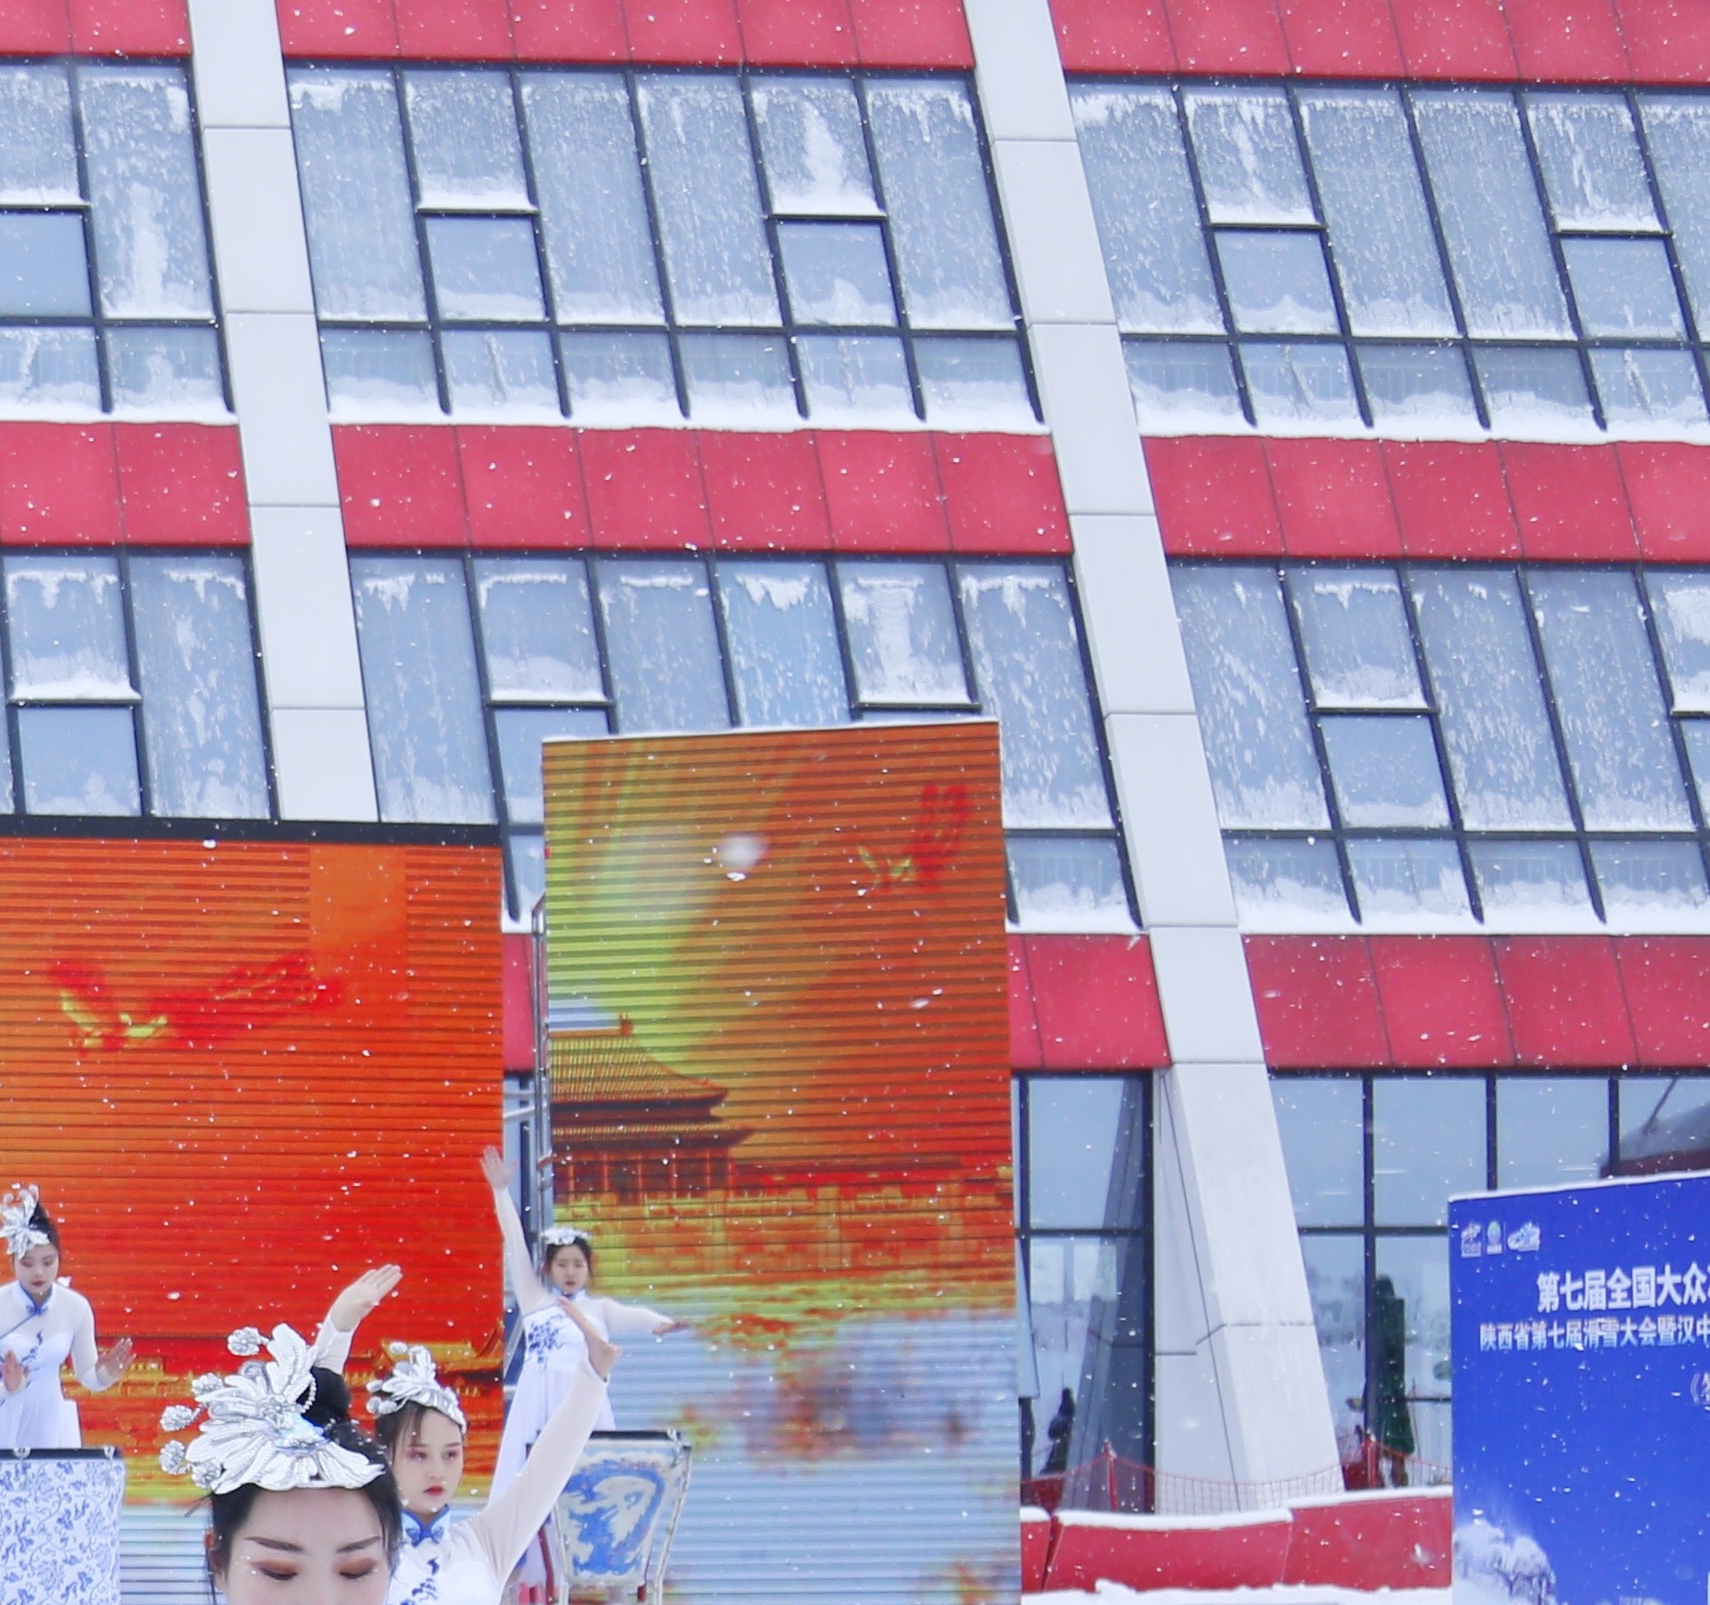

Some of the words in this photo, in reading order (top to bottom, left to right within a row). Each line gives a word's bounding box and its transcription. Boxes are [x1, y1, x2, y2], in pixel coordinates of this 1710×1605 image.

[1537, 1261, 1710, 1313] 第七届全国大众
